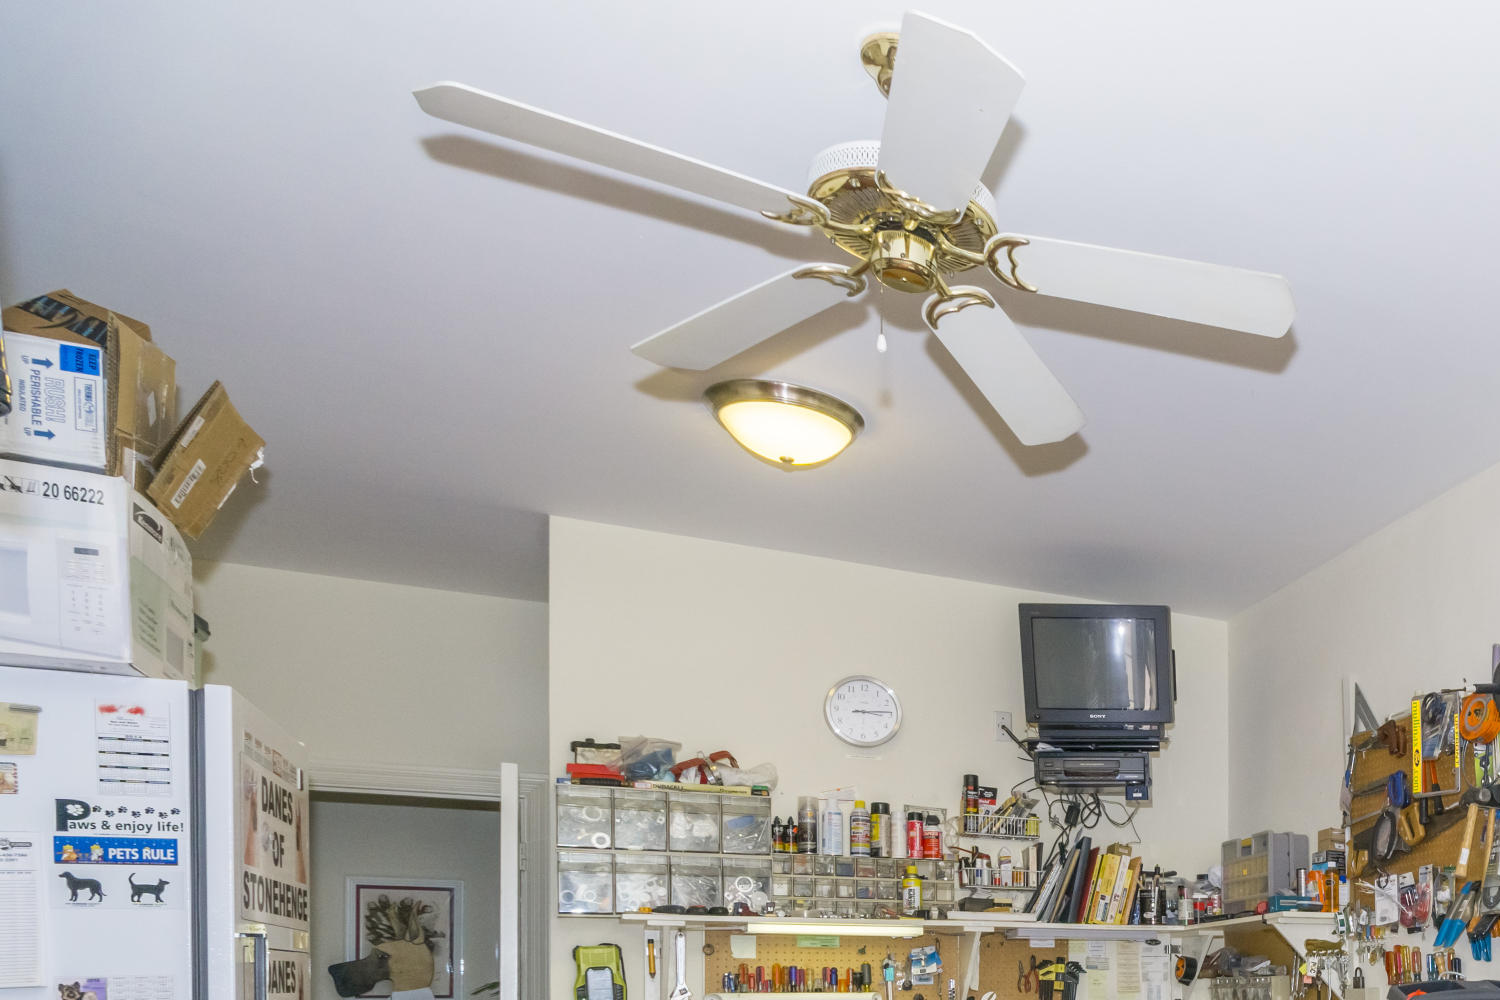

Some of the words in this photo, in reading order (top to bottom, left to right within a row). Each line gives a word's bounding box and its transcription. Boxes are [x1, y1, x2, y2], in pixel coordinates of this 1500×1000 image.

[18, 379, 26, 412] INSULATED
[30, 369, 43, 426] PERISHABLE
[44, 376, 66, 424] RUSH!
[24, 426, 32, 436] UP
[42, 481, 60, 499] 20
[63, 485, 105, 506] 66222
[261, 775, 293, 826] DANES
[100, 820, 111, 831] &
[115, 822, 153, 834] enjoy
[157, 821, 184, 832] life!
[108, 847, 139, 860] PETS
[142, 848, 175, 861] RULE
[272, 831, 285, 869] OF
[243, 870, 308, 922] STONEHENGE
